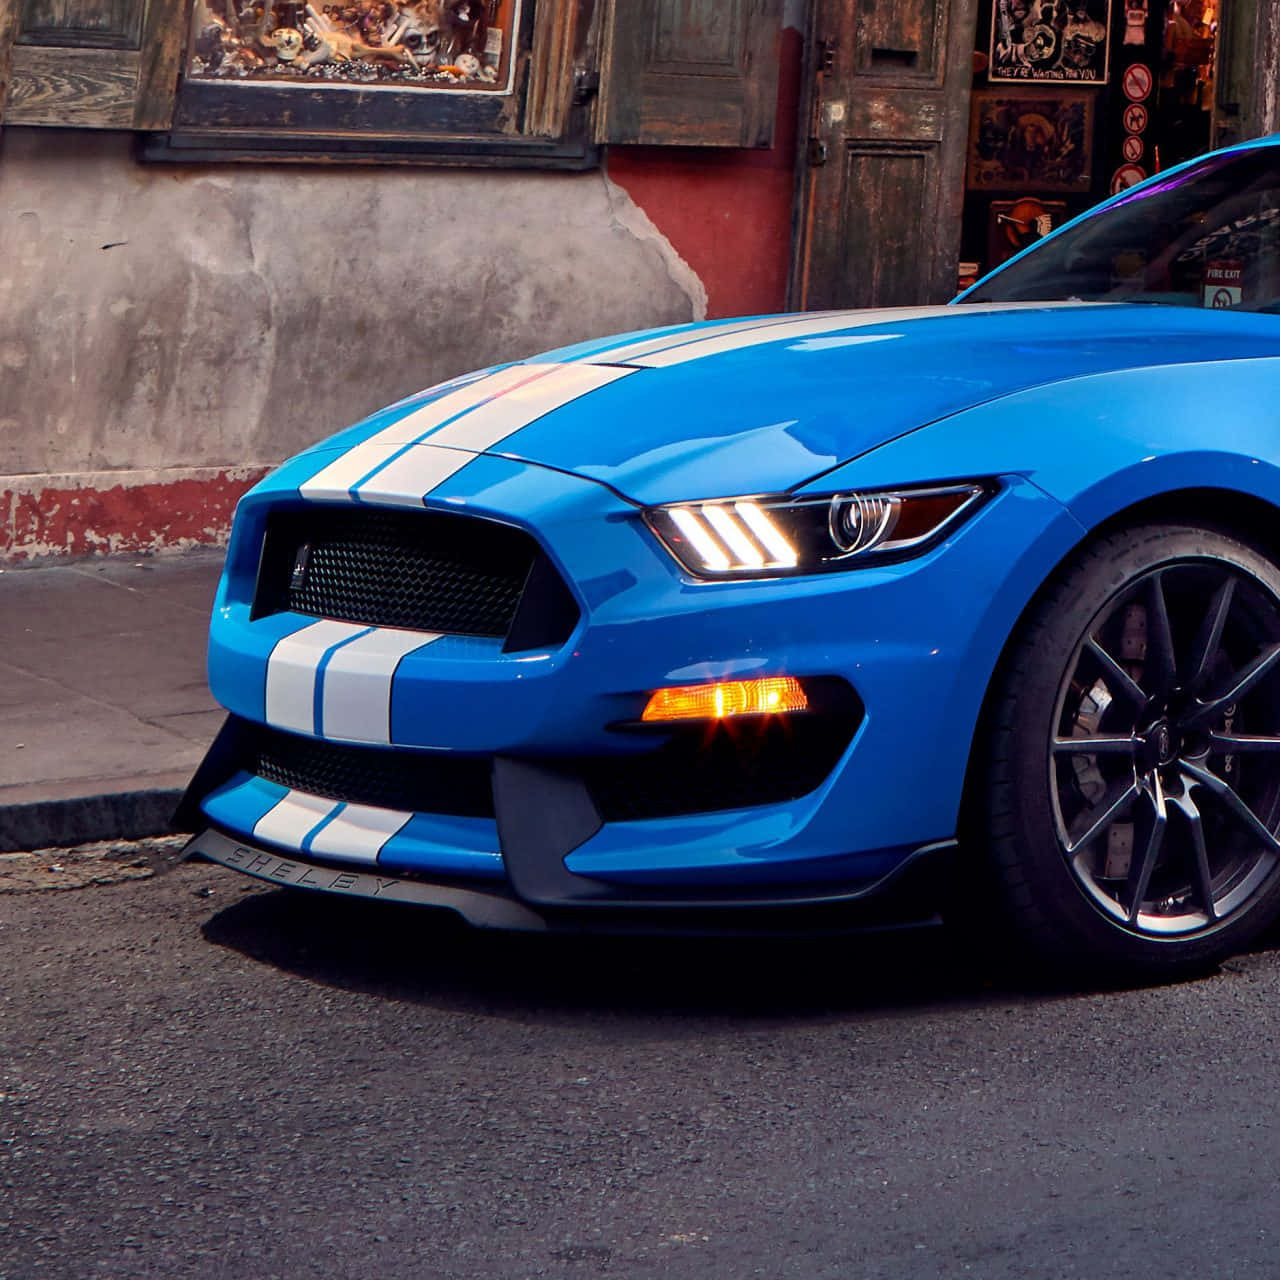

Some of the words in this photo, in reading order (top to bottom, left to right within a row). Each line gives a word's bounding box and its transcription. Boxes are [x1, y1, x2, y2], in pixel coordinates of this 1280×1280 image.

[1080, 67, 1097, 80] YOU
[1224, 269, 1241, 280] EXIT
[225, 846, 401, 897] SHELBY
